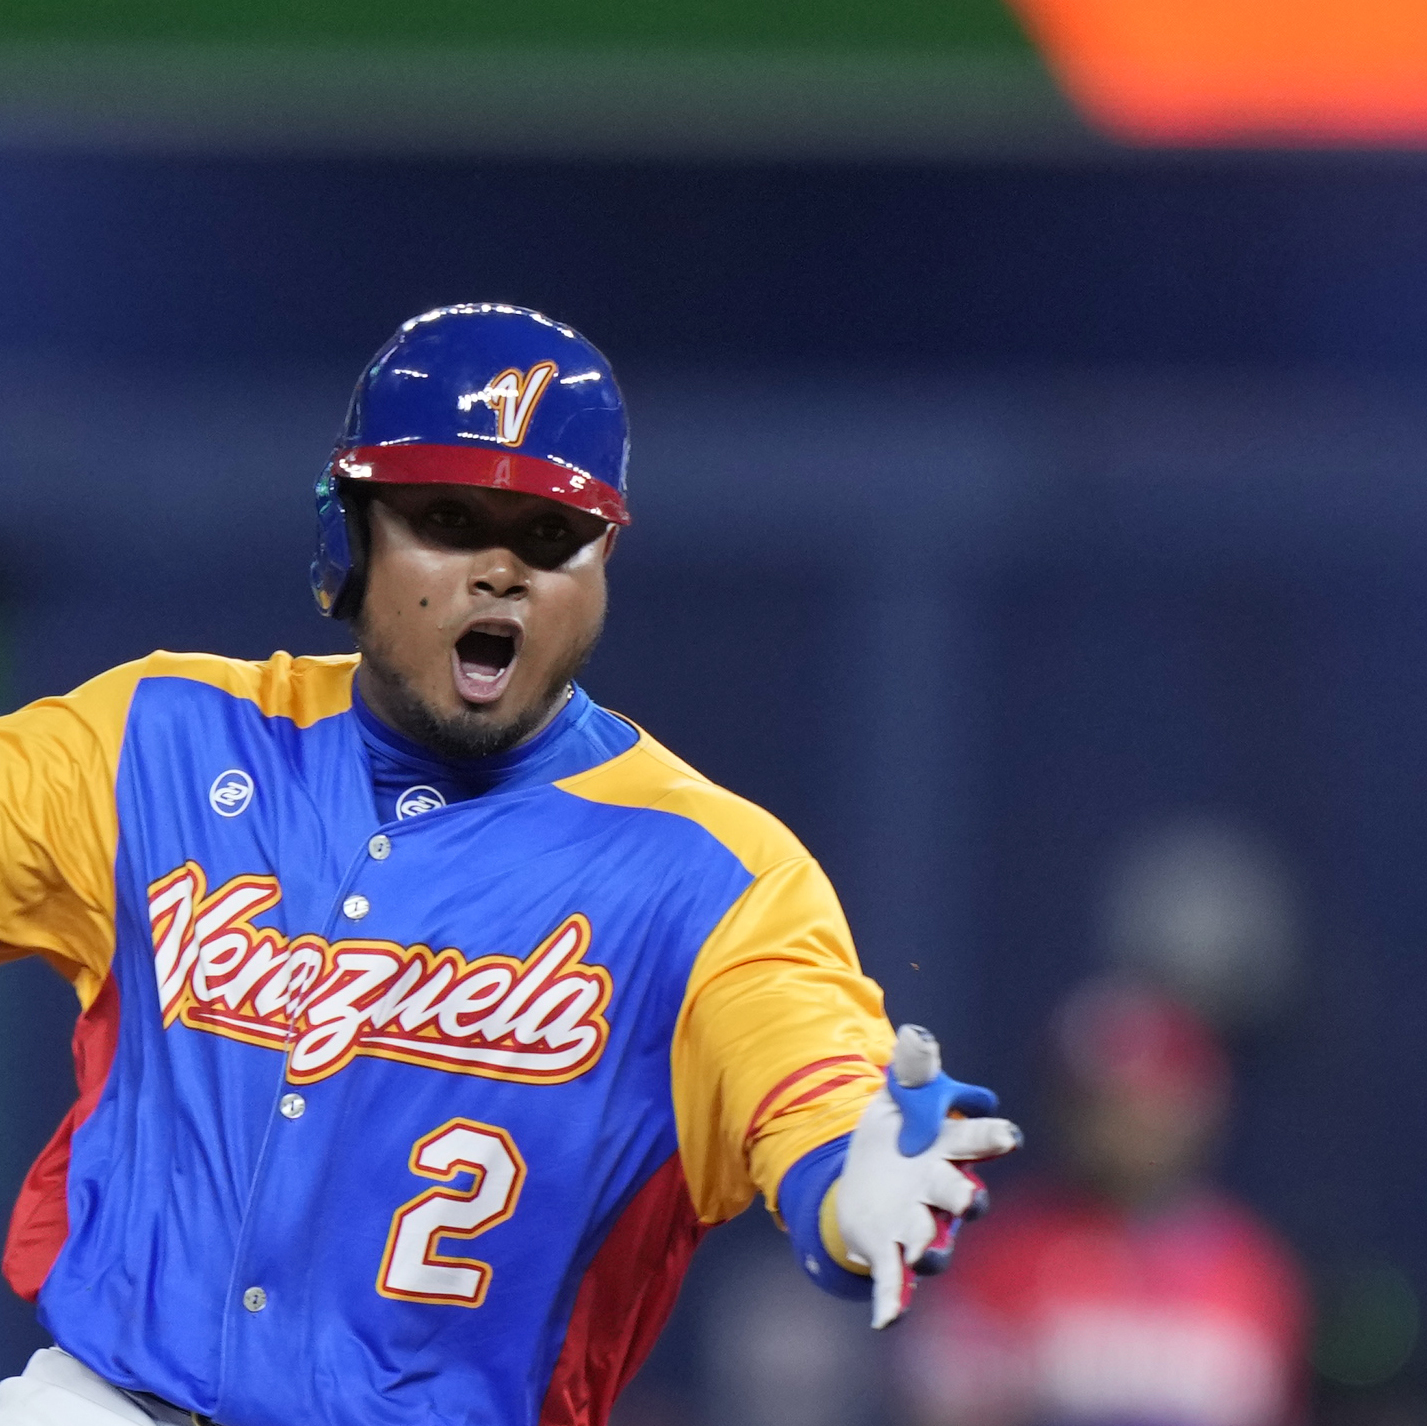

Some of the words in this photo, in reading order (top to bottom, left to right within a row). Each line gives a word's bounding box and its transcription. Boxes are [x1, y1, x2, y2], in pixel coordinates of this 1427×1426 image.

[486, 360, 558, 447] V
[147, 860, 614, 1085] Venezuela
[377, 1117, 527, 1309] 2
